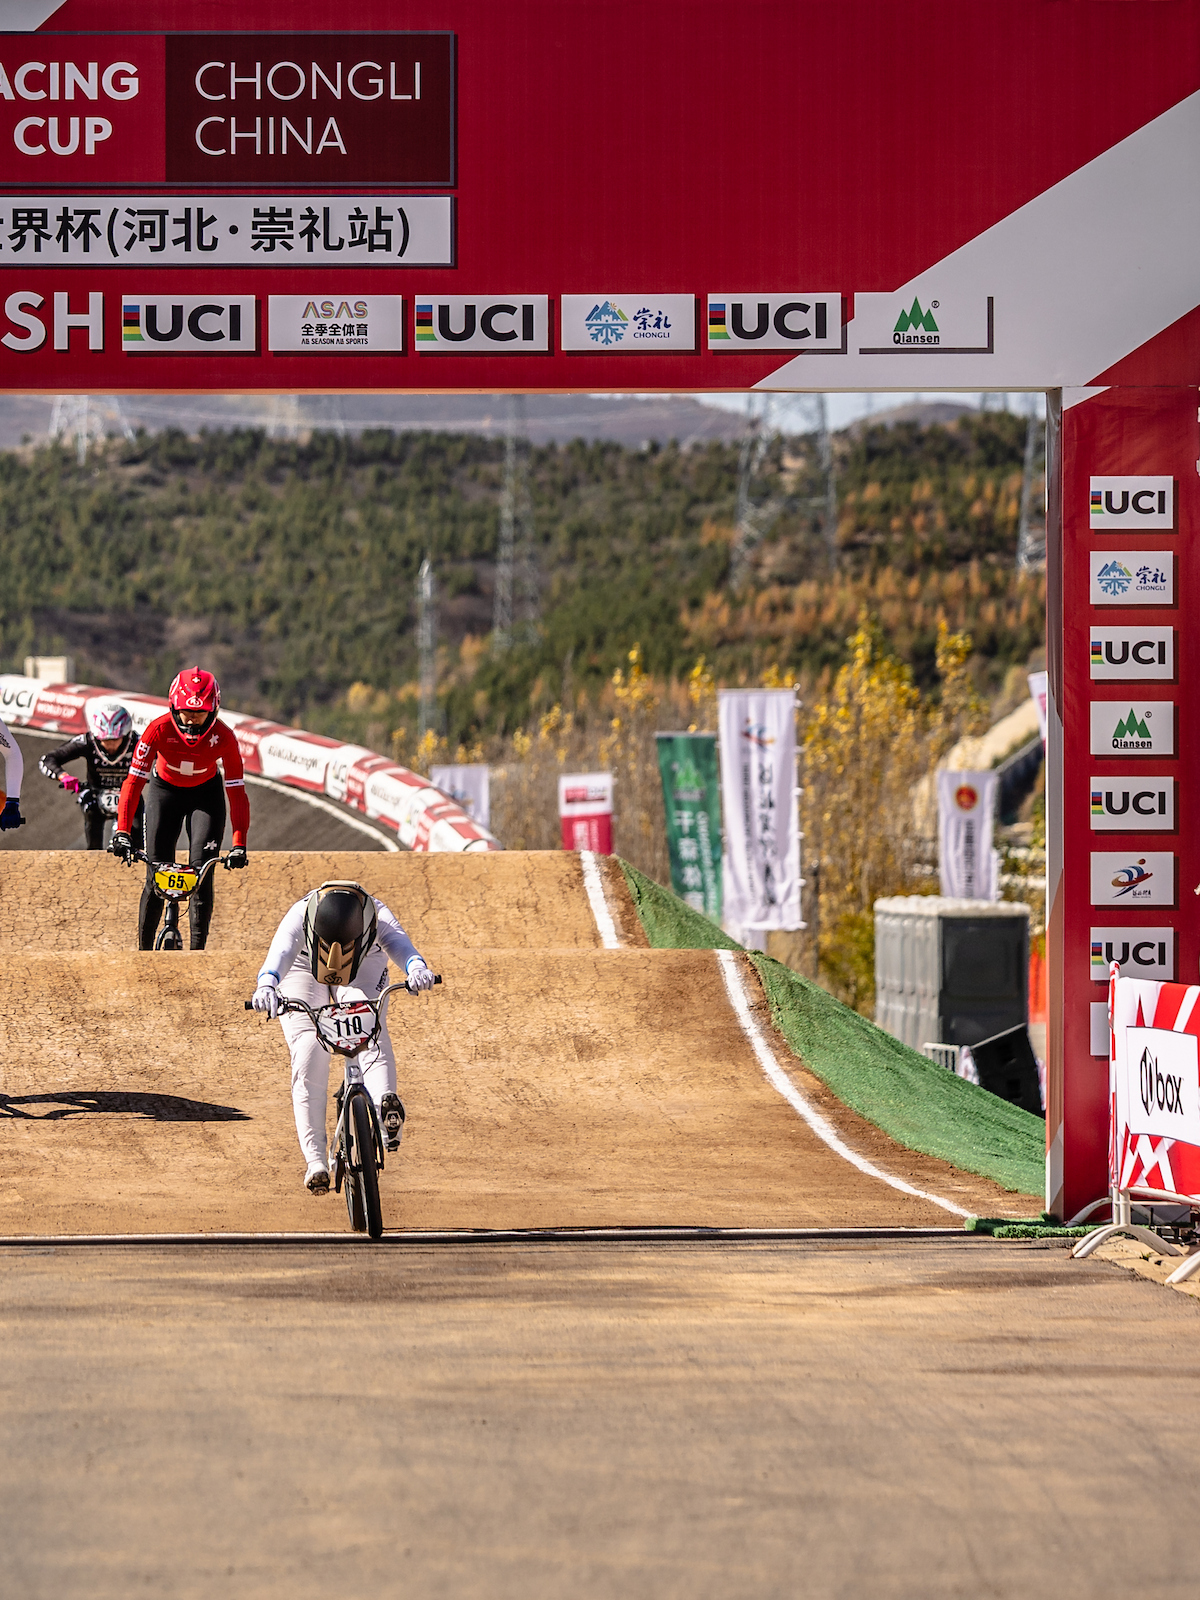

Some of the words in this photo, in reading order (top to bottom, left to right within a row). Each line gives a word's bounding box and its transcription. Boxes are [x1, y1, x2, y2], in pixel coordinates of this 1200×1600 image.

[196, 62, 420, 100] CHONGLI
[14, 117, 112, 155] CUP
[196, 117, 347, 155] CHINA
[302, 301, 368, 319] ASAS
[633, 308, 672, 331] 崇礼
[731, 302, 827, 340] UCI
[145, 304, 241, 342] UCI
[301, 323, 369, 337] 全季全体育
[437, 304, 534, 342] UCI
[892, 332, 940, 345] Qiansen
[1104, 491, 1166, 514] UCI
[1104, 640, 1166, 665] UCI
[2, 688, 34, 709] UCI
[1111, 736, 1153, 750] Qiansen
[1105, 791, 1166, 815] UCI
[168, 874, 184, 889] 65
[1105, 941, 1166, 966] UCI
[333, 1015, 363, 1038] 110
[1155, 1056, 1184, 1116] box
